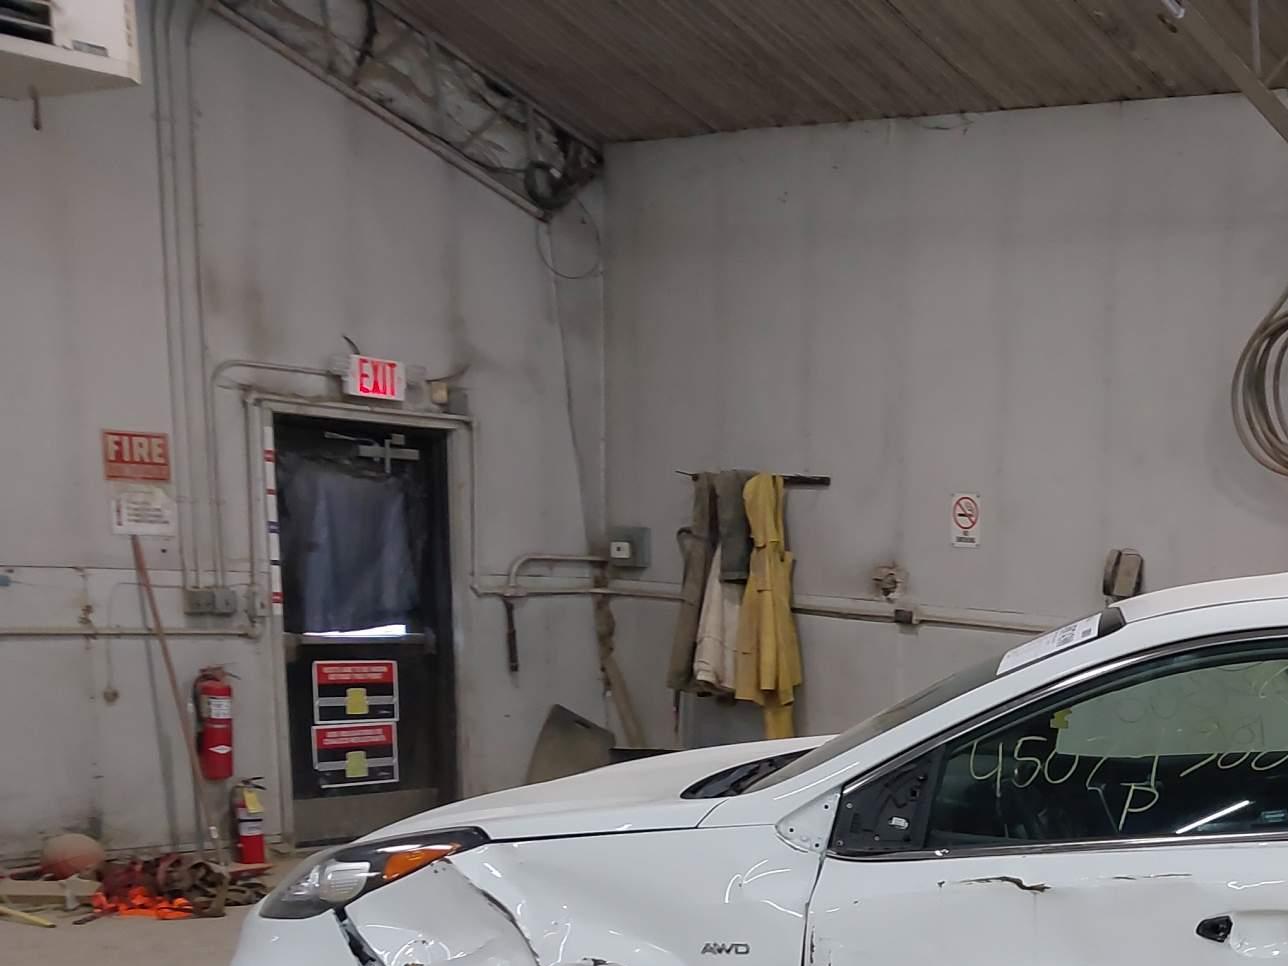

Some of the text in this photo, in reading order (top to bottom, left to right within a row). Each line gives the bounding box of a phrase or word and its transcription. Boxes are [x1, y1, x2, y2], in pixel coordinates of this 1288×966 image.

[358, 358, 397, 397] EXIT
[105, 434, 167, 464] FIRE
[700, 942, 750, 955] AWD
